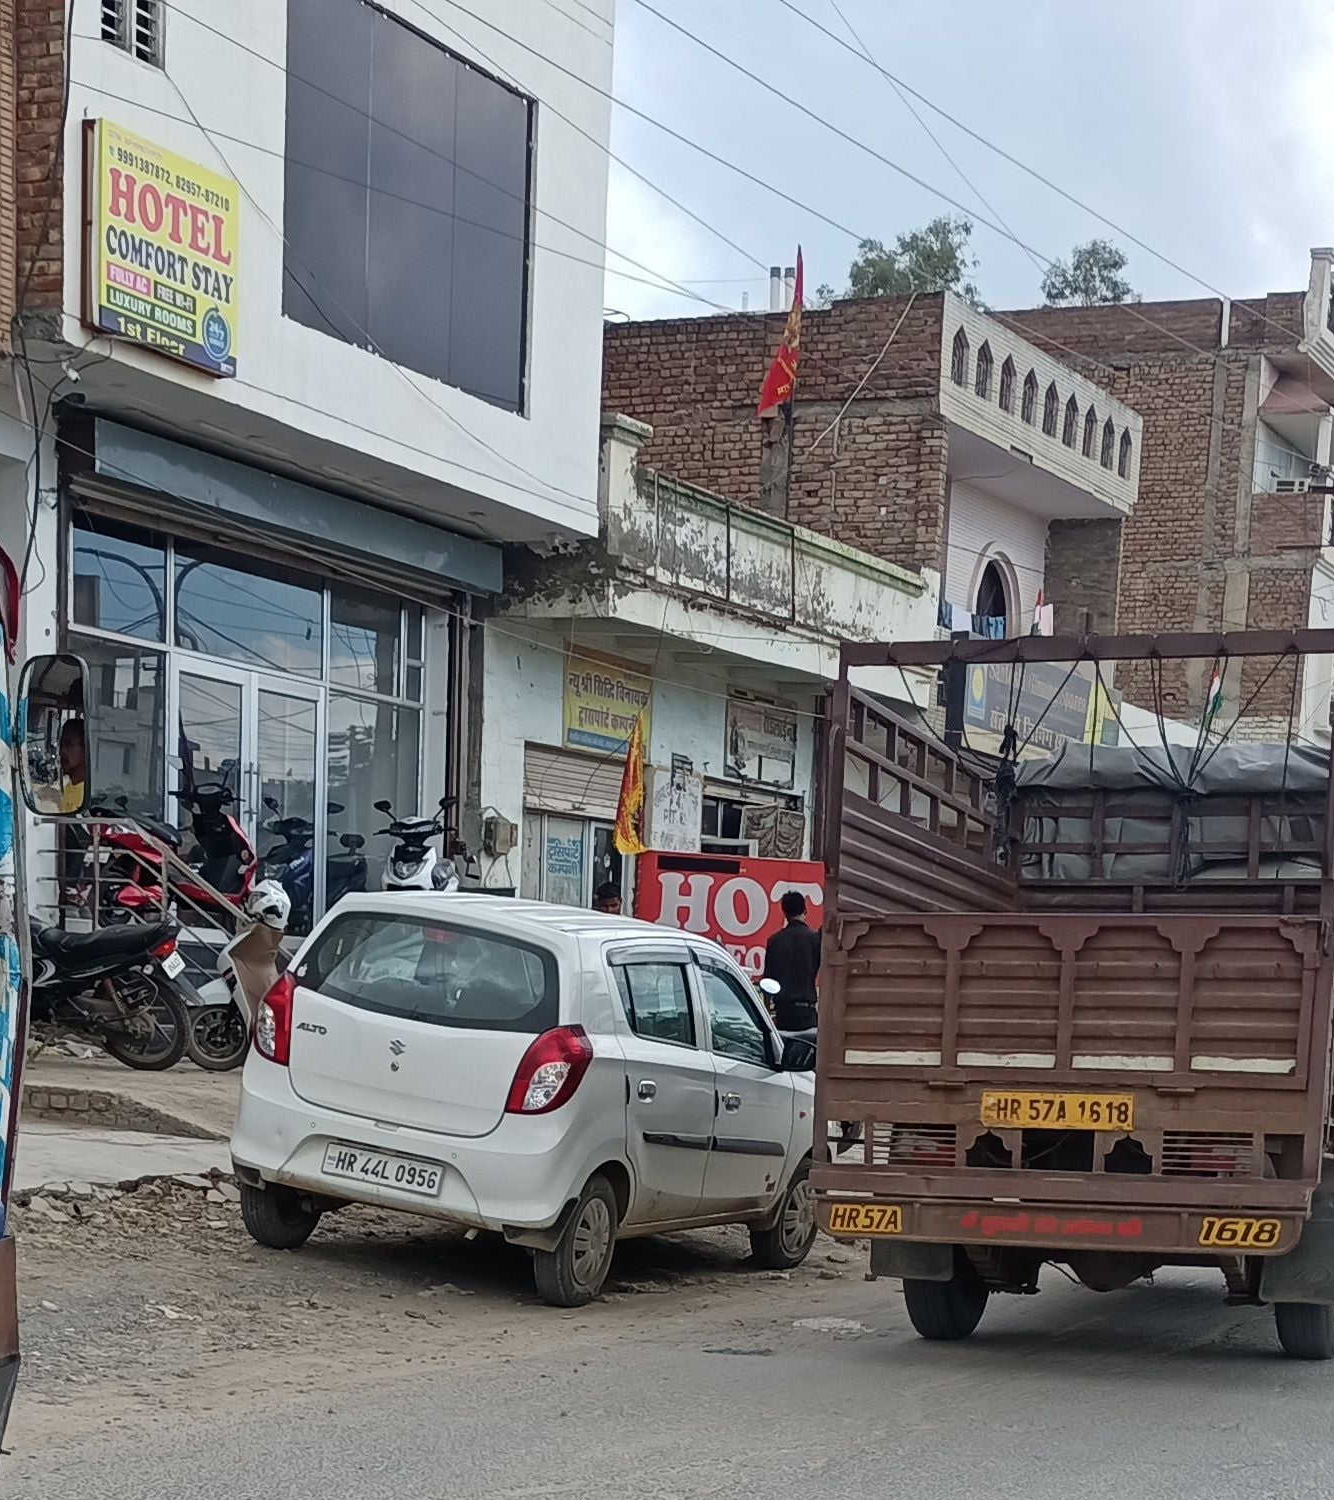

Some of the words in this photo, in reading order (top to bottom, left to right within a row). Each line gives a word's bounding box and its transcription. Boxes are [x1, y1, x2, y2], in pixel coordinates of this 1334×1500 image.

[109, 167, 231, 266] HOTEL
[106, 224, 188, 285] COMFORT
[192, 261, 233, 304] STAY
[109, 288, 152, 317] LUXURY
[155, 305, 194, 335] ROOMS
[117, 317, 142, 340] 1st
[147, 328, 186, 356] Floor
[296, 1022, 327, 1035] ALTO
[996, 1100, 1020, 1120] HR
[1028, 1100, 1066, 1120] 57A
[1077, 1100, 1129, 1123] 1618
[335, 1151, 357, 1172] HR
[360, 1158, 389, 1180] 44L
[395, 1165, 438, 1189] 0956
[1202, 1219, 1279, 1243] 1618
